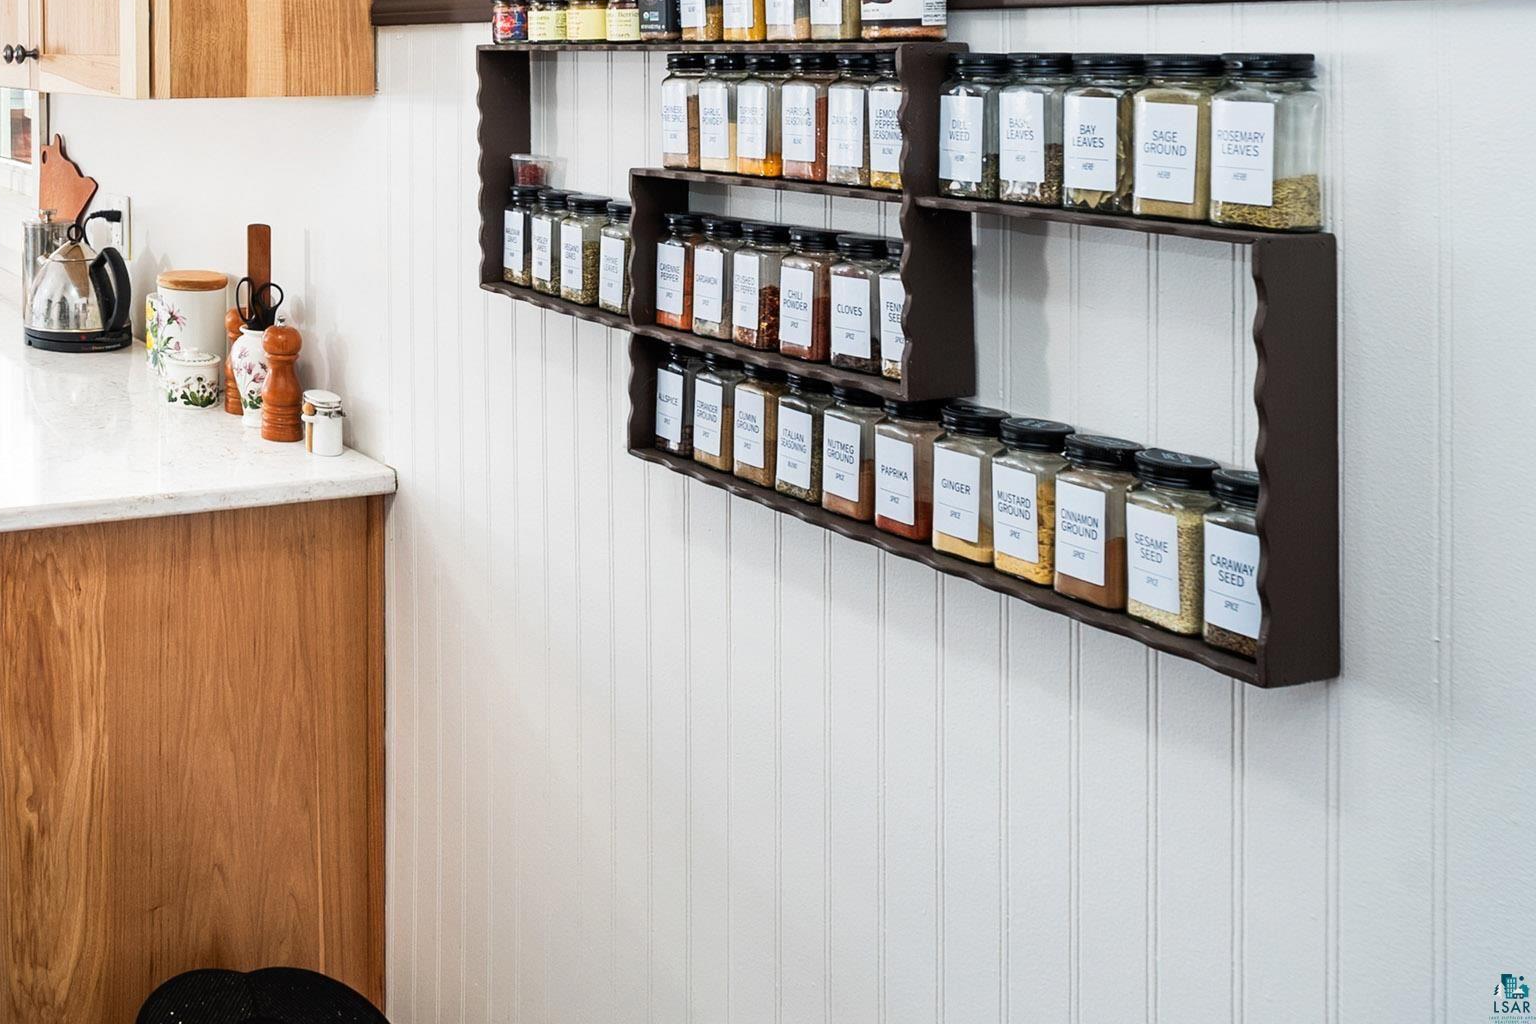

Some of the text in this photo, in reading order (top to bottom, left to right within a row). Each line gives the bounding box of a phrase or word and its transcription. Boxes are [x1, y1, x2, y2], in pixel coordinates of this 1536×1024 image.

[875, 109, 897, 119] LEMON
[949, 130, 969, 141] WEED
[1006, 129, 1034, 141] LEAVES
[1079, 124, 1096, 135] BAY
[1152, 129, 1178, 143] SAGE
[1216, 129, 1265, 143] ROSEMARY
[1072, 136, 1105, 149] LEAVES
[1143, 142, 1187, 157] GROUND
[1221, 143, 1260, 157] LEAVES
[660, 272, 679, 282] PEPPER
[787, 289, 803, 301] CHILI
[783, 298, 808, 311] POWDER
[837, 303, 863, 317] CLOVES
[886, 301, 904, 312] FENN
[888, 312, 901, 324] SEE
[738, 411, 757, 424] CUMIN
[736, 419, 760, 434] GROUND
[782, 427, 805, 442] ITALIAN
[780, 438, 807, 454] SEASONING
[827, 438, 855, 454] NUTMEG
[827, 448, 855, 465] GROUND
[880, 464, 909, 481] PAPRIKA
[941, 478, 971, 495] GINGER
[997, 489, 1031, 509] MUSTARD
[950, 510, 961, 520] SPICE
[997, 502, 1031, 521] GROUND
[1061, 508, 1099, 528] CINNAMON
[1009, 530, 1020, 540] SPICE
[1061, 520, 1098, 541] GROUND
[1134, 532, 1168, 553] SESAME
[1073, 549, 1086, 560] SPICE
[1140, 547, 1163, 564] SEED
[1210, 553, 1255, 576] CARAWAY
[1146, 576, 1159, 588] SPICE
[1218, 570, 1245, 588] SEED
[1224, 600, 1239, 613] SPICE
